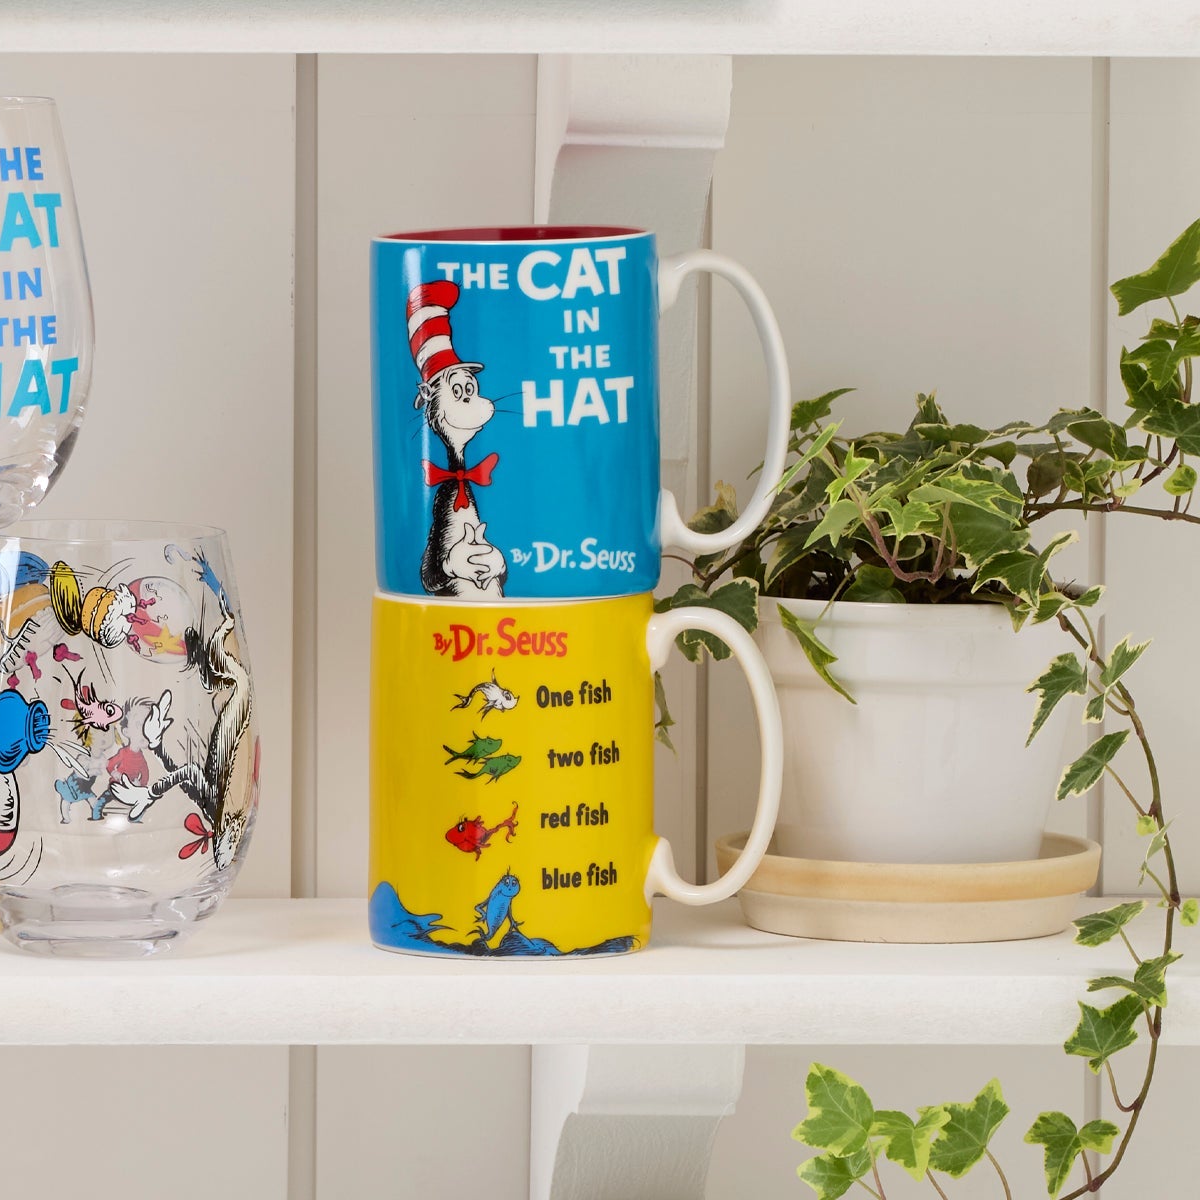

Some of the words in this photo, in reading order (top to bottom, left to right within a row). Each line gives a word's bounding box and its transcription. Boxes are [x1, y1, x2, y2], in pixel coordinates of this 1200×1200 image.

[1, 267, 42, 300] IN
[437, 262, 509, 290] THE
[517, 246, 627, 301] CAT
[563, 307, 600, 334] IN
[549, 344, 611, 369] THE
[522, 376, 634, 428] HAT
[510, 548, 533, 567] By
[531, 541, 576, 573] Dr.
[579, 537, 637, 573] Seuss
[433, 632, 452, 656] By
[450, 624, 493, 662] Dr.
[496, 617, 568, 658] Seuss
[536, 685, 574, 709] One
[579, 679, 612, 705] fish
[547, 749, 584, 769] two
[589, 740, 620, 765] fish
[540, 805, 570, 829] red
[576, 802, 609, 826] fish
[542, 867, 582, 890] blue
[586, 861, 617, 886] fish
